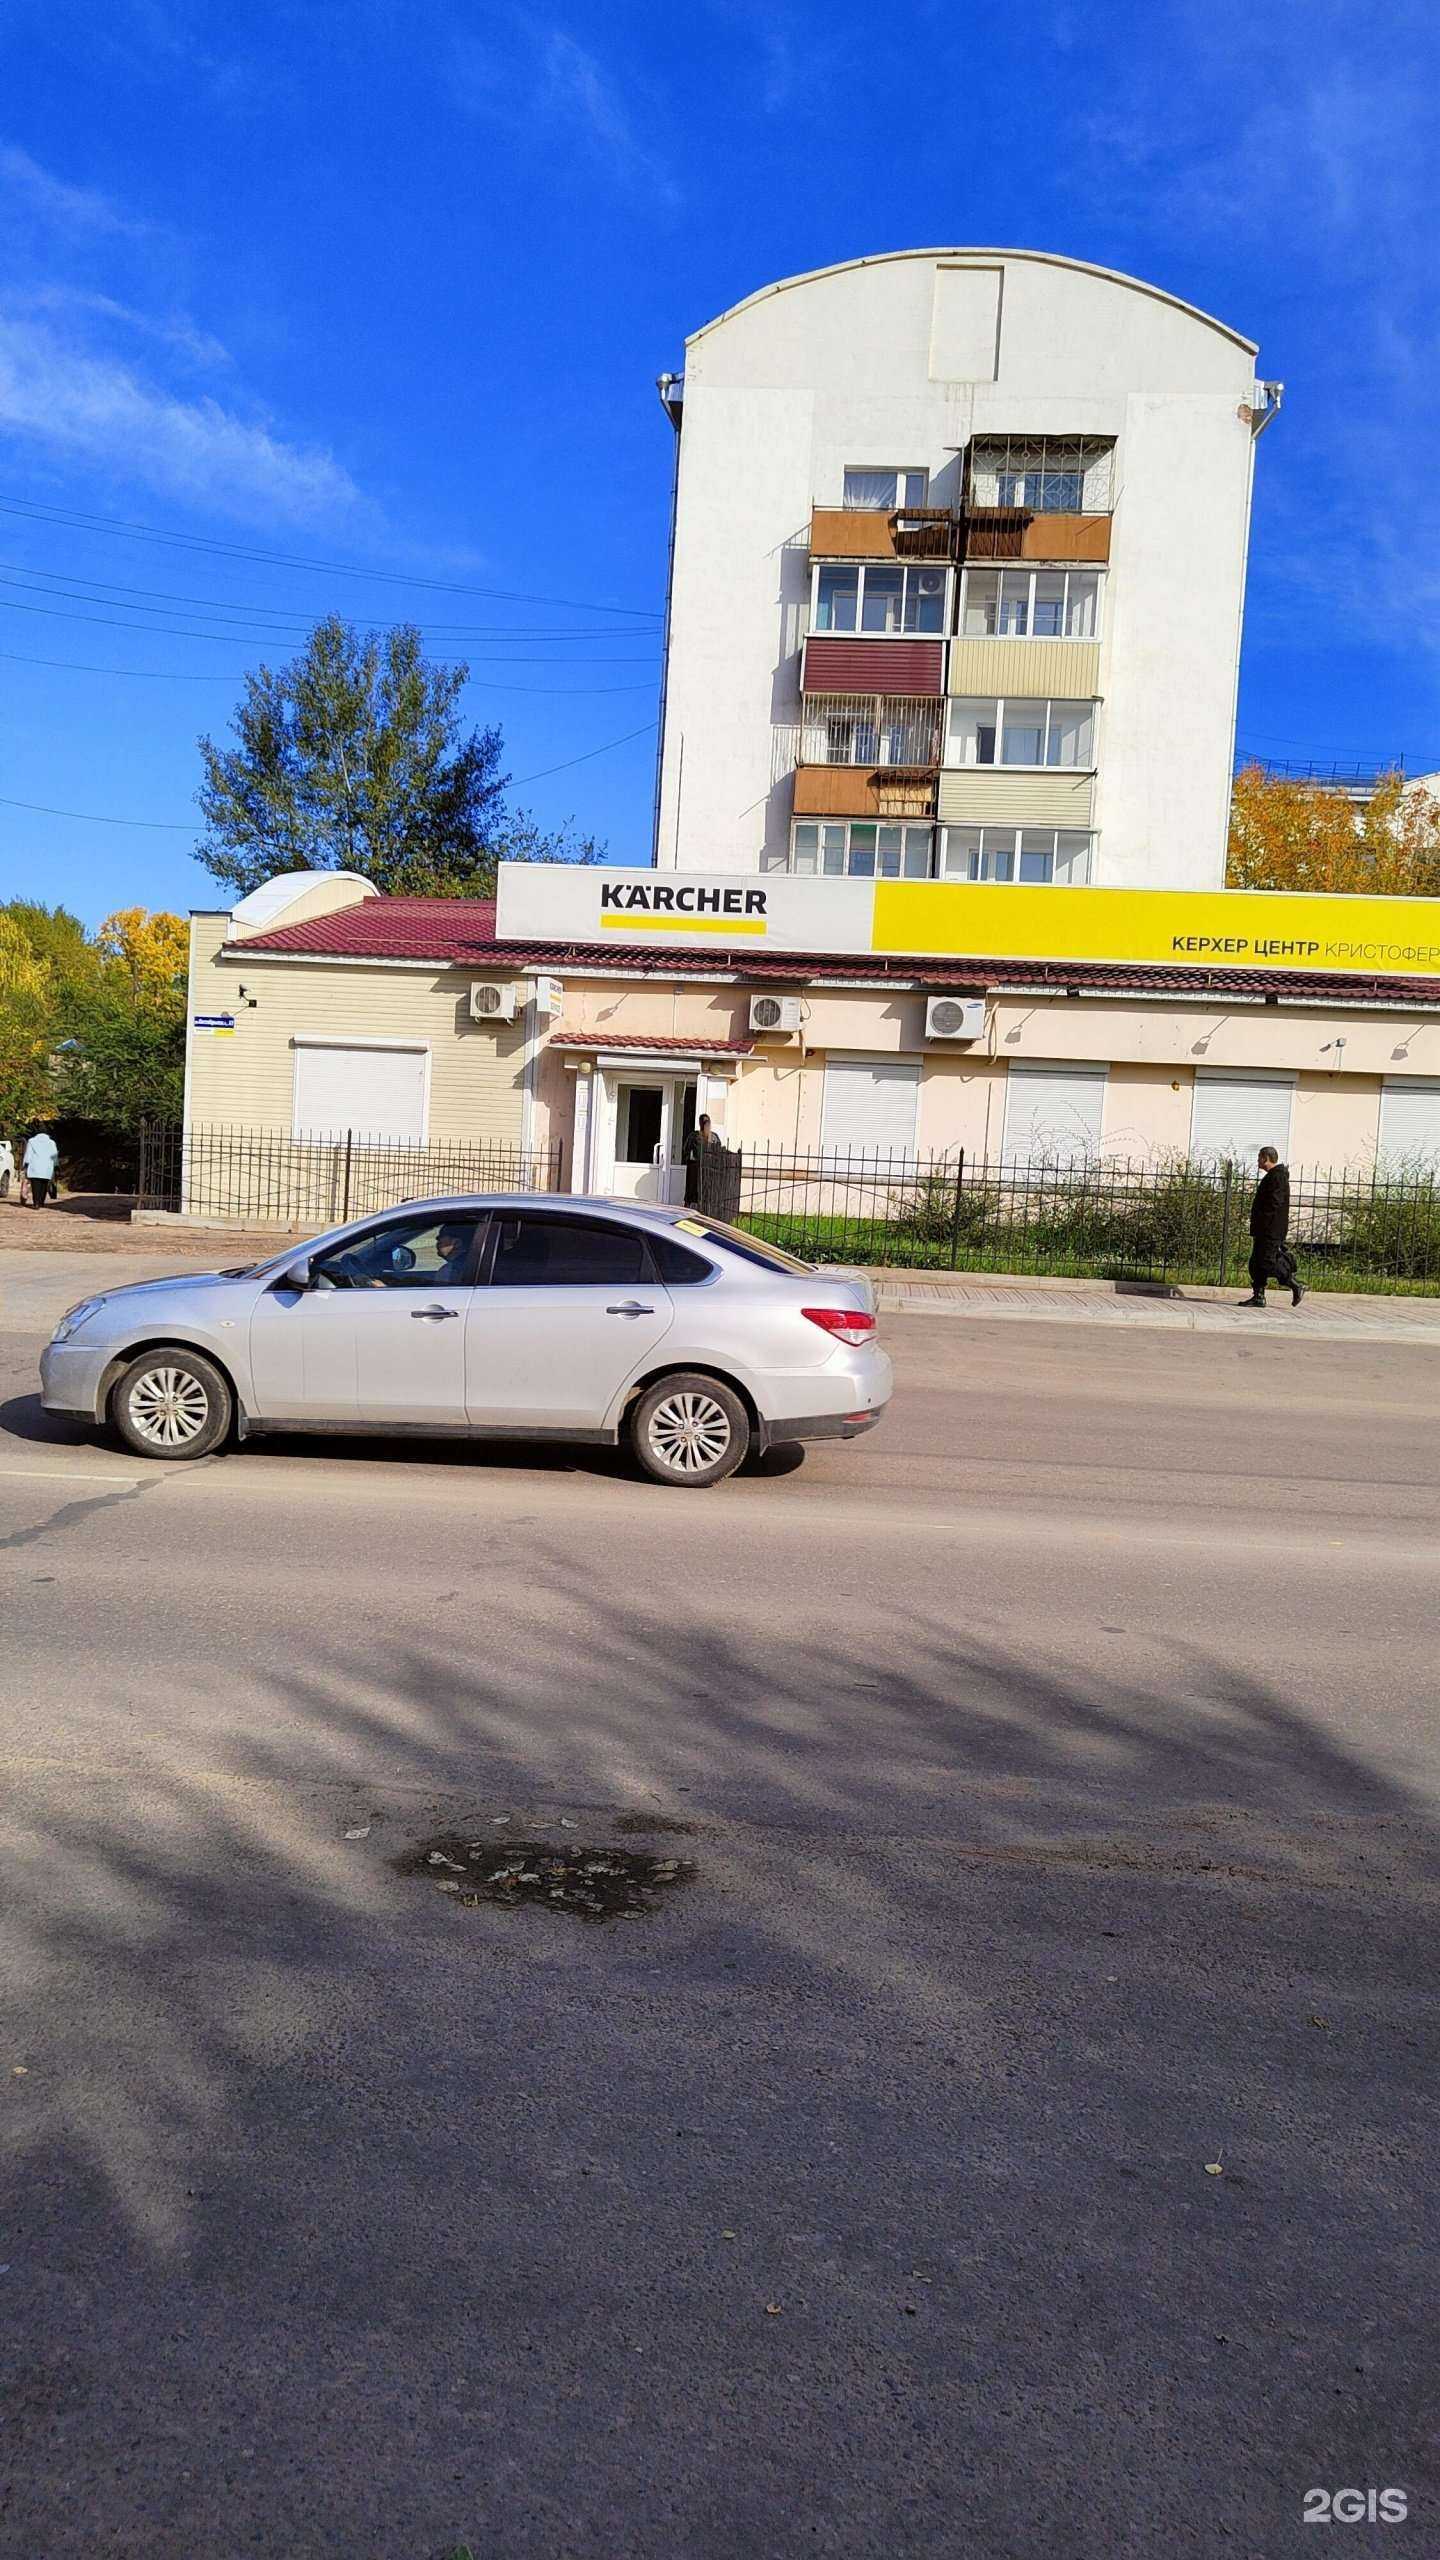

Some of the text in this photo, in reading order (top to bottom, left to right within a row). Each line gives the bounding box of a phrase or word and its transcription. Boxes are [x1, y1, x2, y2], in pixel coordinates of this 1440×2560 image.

[601, 884, 767, 915] KÄRCHER
[1172, 936, 1440, 962] КЕРХЕР ЦЕНТР КРИСТОФЕР
